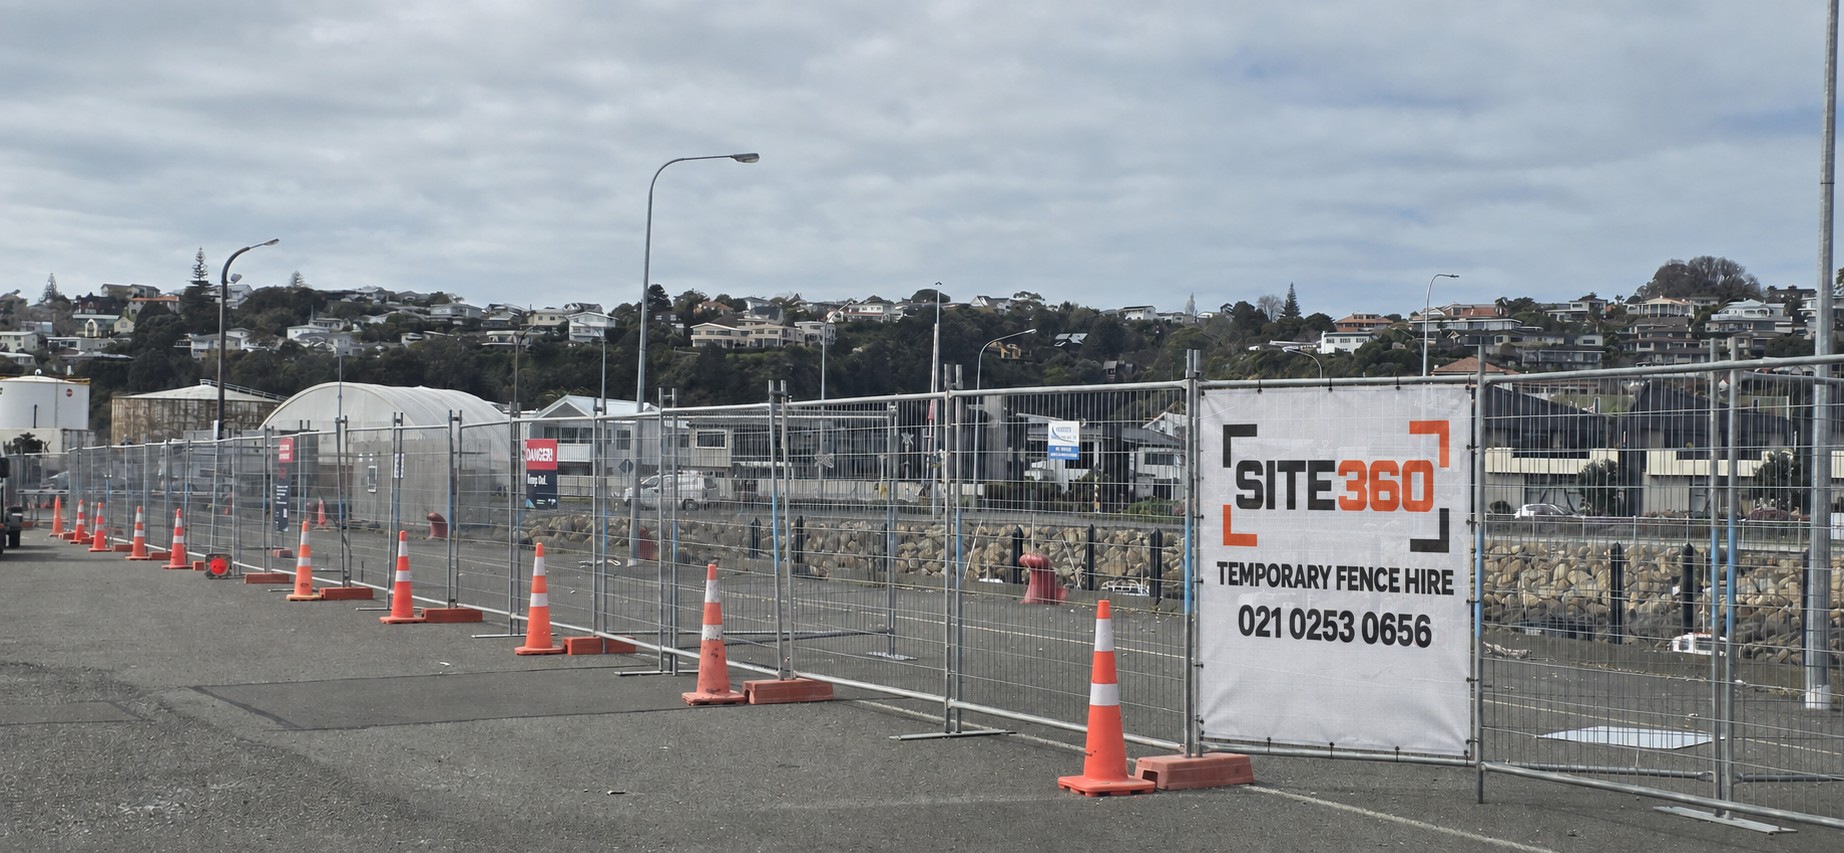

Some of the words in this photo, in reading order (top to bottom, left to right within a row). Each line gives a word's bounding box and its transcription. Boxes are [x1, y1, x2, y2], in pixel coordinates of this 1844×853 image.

[1235, 460, 1434, 513] SITE360
[1216, 561, 1333, 590] TEMPORARY
[1336, 565, 1401, 593] FENCE
[1404, 567, 1455, 596] HIRE
[1238, 604, 1282, 639] 021
[1289, 607, 1356, 643] 0253
[1361, 611, 1432, 649] 0656
